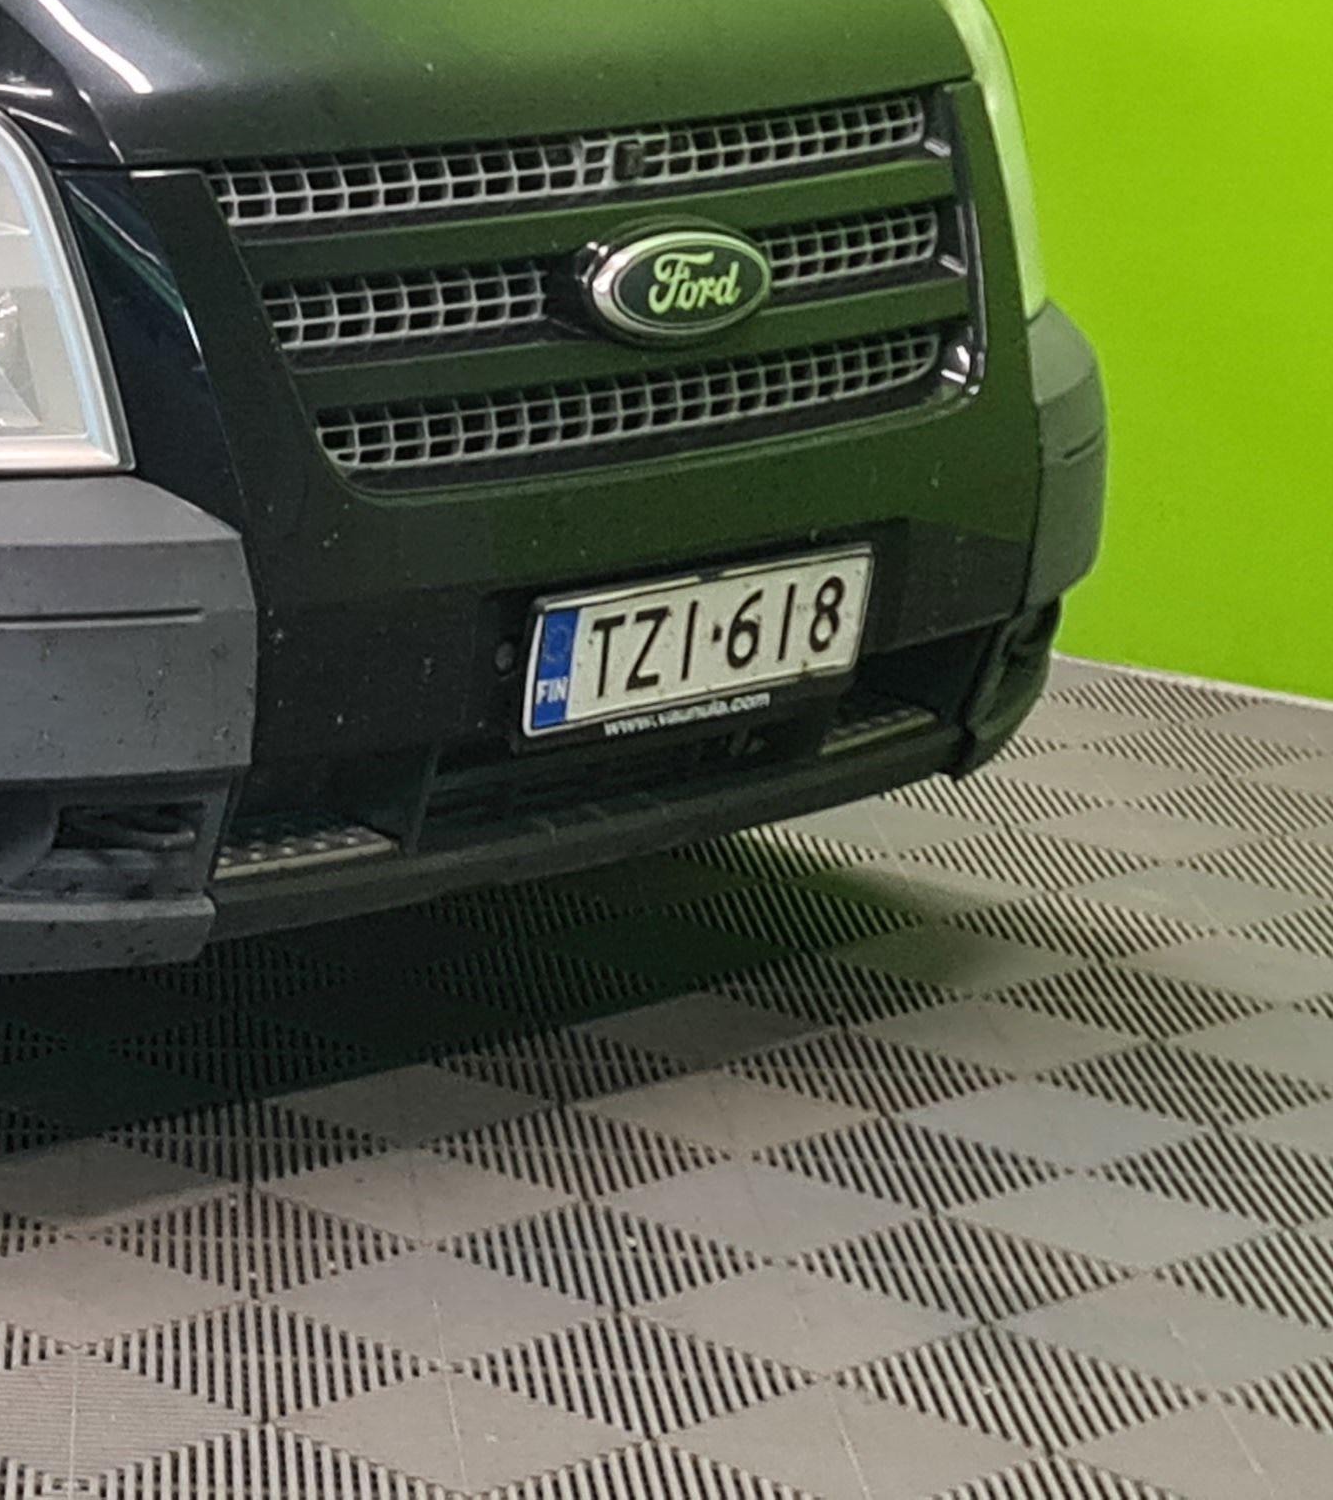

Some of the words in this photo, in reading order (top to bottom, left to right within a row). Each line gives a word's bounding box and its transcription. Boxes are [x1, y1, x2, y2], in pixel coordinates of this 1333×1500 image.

[648, 251, 742, 314] Ford
[592, 575, 846, 698] TZI-618
[535, 675, 569, 703] FIN
